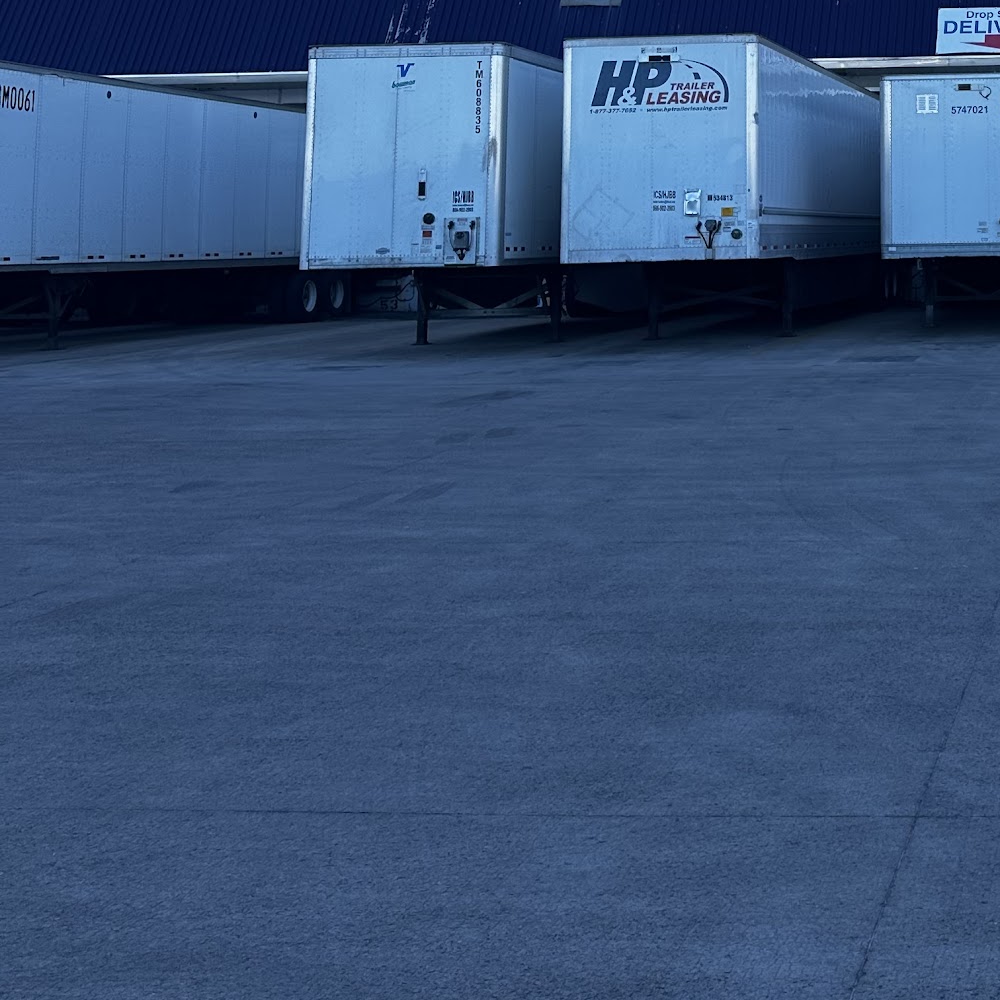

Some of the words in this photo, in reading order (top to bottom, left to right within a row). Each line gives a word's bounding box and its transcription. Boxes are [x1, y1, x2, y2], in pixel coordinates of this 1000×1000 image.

[966, 10, 993, 20] Drop
[670, 82, 715, 91] TRAILER
[0, 85, 36, 113] M0061
[475, 60, 484, 134] TM608835
[645, 90, 722, 106] LEASING
[951, 106, 989, 115] 5747021
[380, 299, 398, 310] 53
